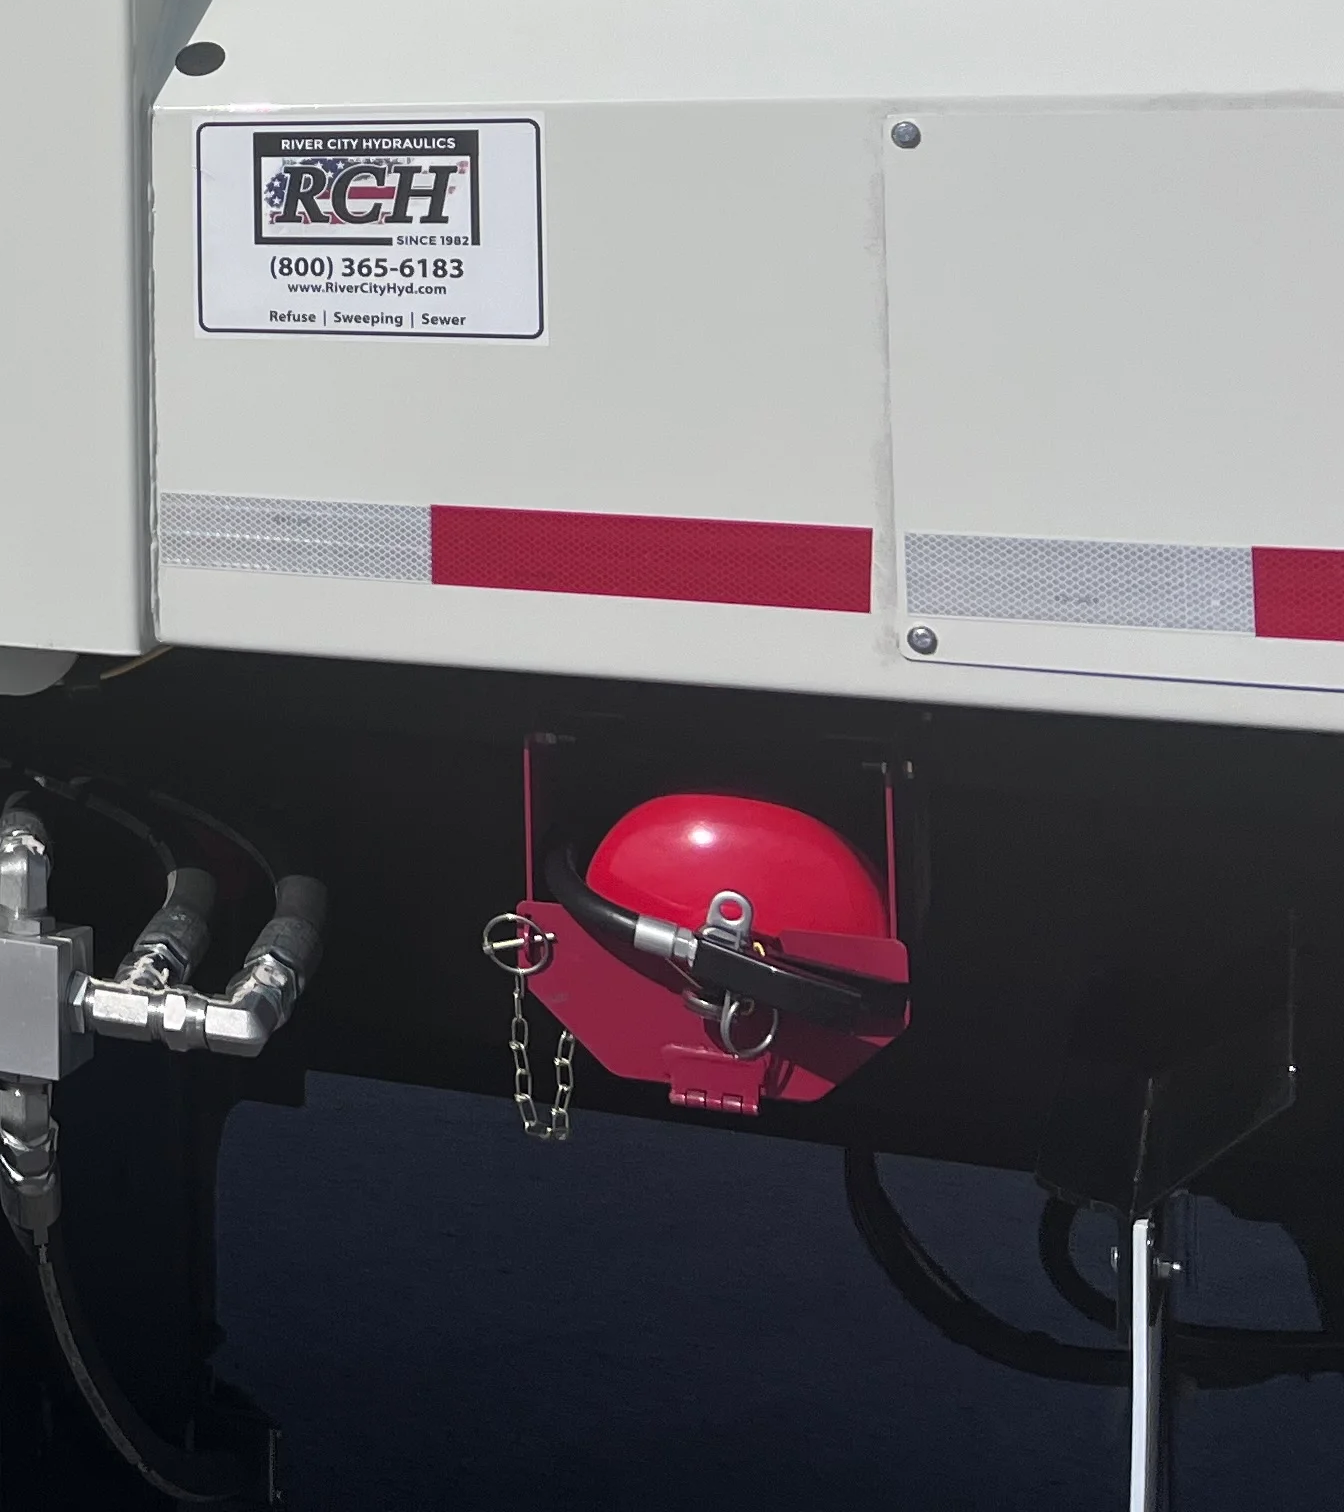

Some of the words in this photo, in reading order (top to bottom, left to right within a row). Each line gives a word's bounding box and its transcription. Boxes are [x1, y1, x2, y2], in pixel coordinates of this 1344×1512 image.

[281, 139, 323, 150] RIVER
[328, 139, 358, 149] CITY
[362, 138, 456, 149] HYDRAULICS
[274, 165, 458, 224] RCH
[397, 236, 437, 245] SINCE
[440, 236, 469, 246] 1982
[270, 256, 334, 280] (800)
[341, 257, 464, 278] 365-6183
[288, 282, 447, 297] www.RiverCityHyd.com
[269, 311, 316, 323] Refuse
[333, 311, 403, 327] Sweeping
[421, 313, 466, 326] Sewer
